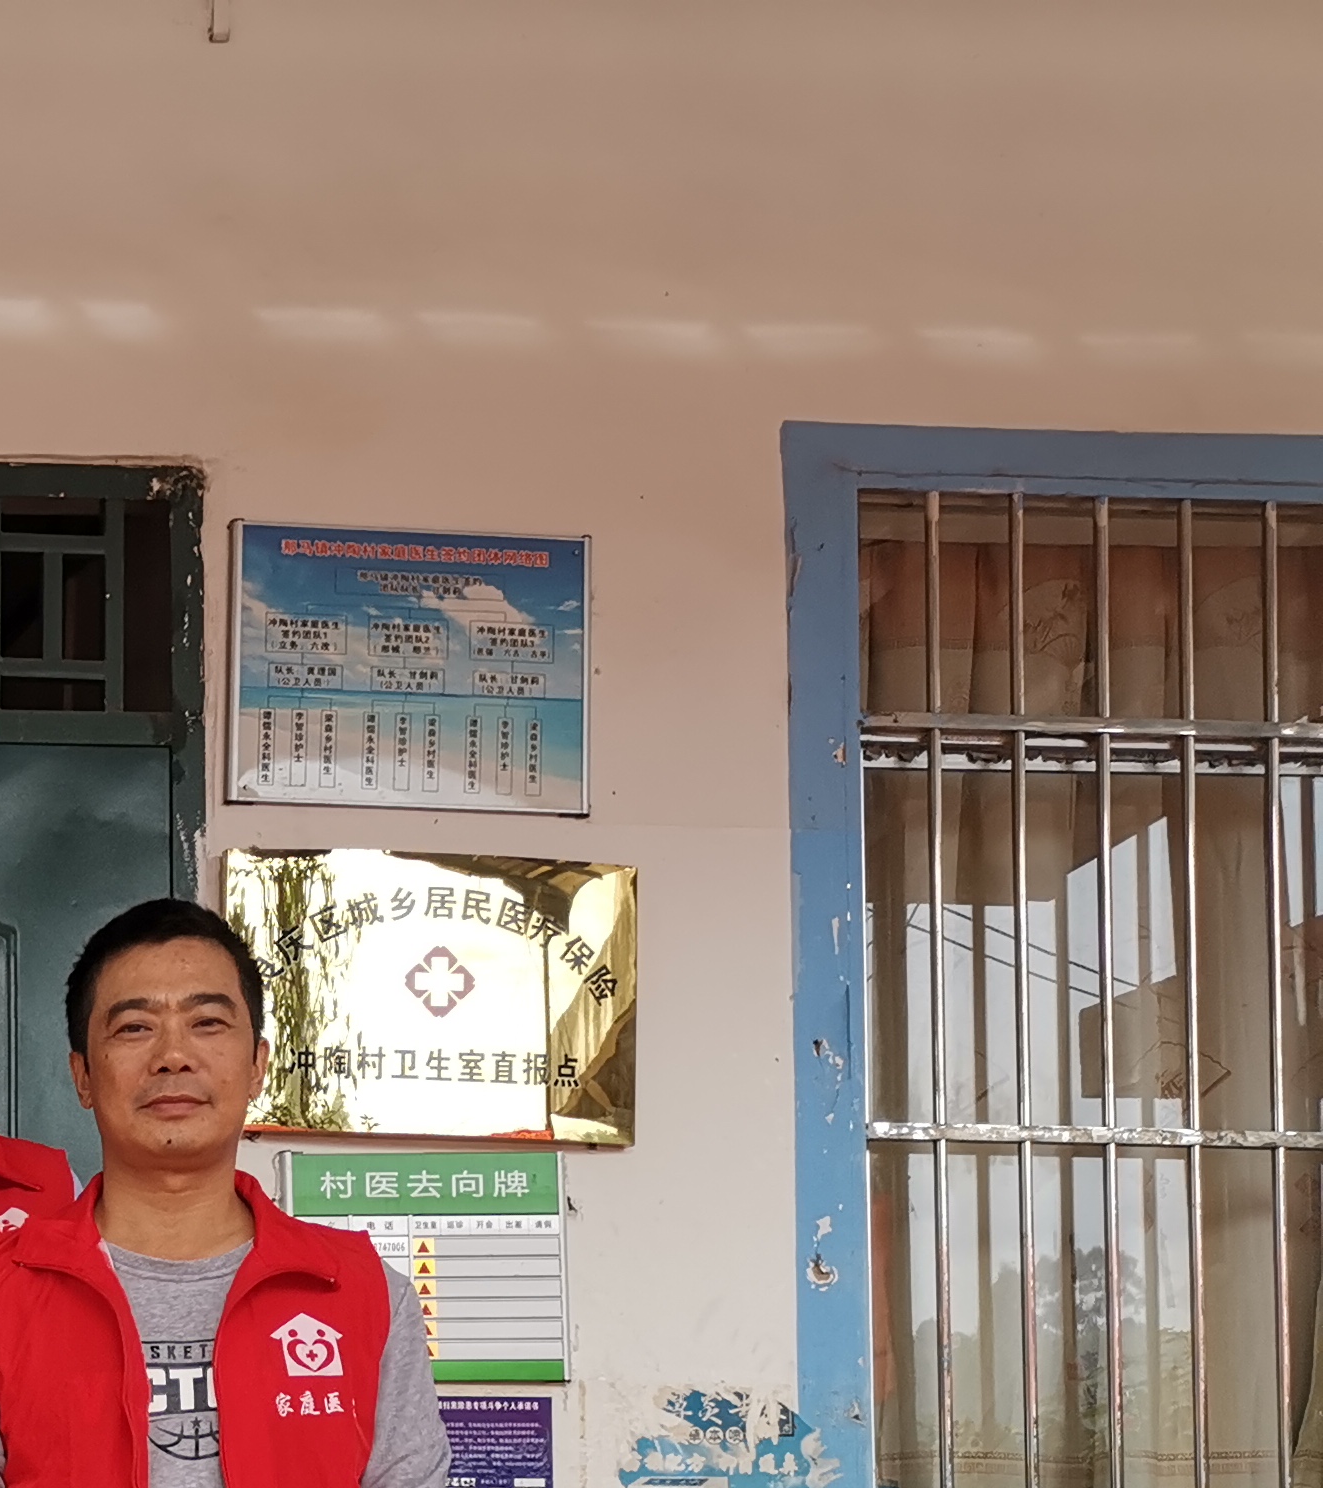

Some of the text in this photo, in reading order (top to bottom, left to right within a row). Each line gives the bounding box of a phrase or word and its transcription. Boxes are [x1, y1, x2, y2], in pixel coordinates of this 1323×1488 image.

[287, 1046, 580, 1089] 冲陶村卫生室直报点
[320, 1169, 530, 1199] 村医去向牌
[146, 1366, 217, 1413] CT
[275, 1390, 355, 1418] 家庭医
